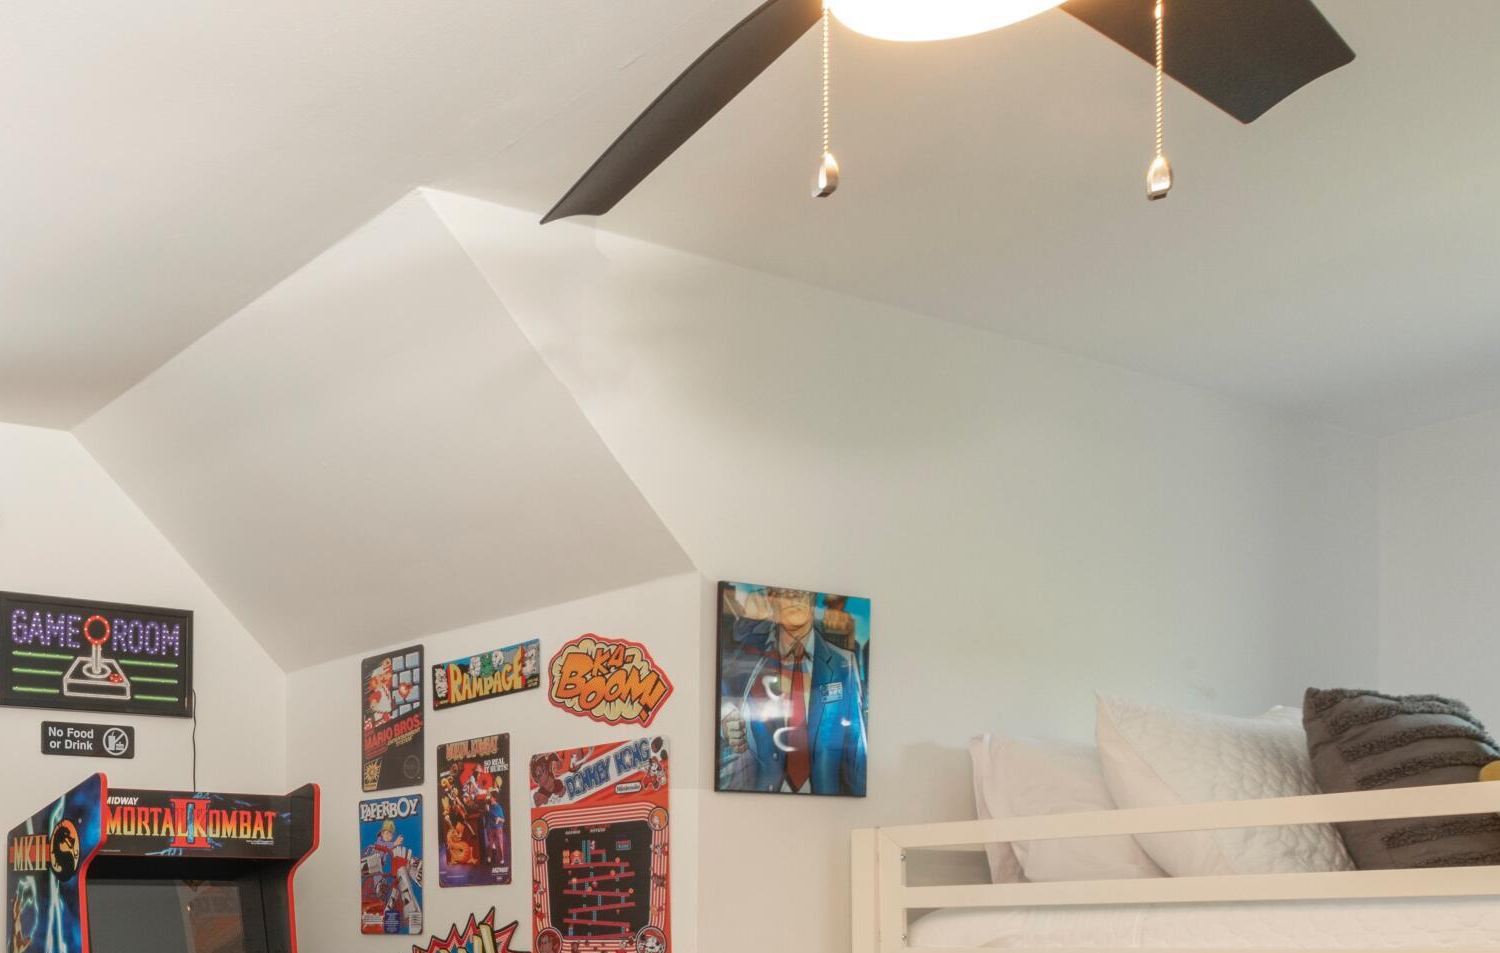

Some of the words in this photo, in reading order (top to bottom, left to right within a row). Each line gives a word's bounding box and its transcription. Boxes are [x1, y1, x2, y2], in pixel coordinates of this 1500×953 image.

[11, 608, 81, 649] GAME
[112, 618, 180, 656] ROOM
[448, 645, 523, 704] RAMPAGE
[555, 652, 668, 723] BOOM!
[48, 727, 64, 738] No
[67, 728, 94, 740] Food
[49, 740, 62, 750] or
[64, 739, 94, 751] Drink
[364, 726, 393, 750] MARIO
[484, 759, 491, 767] SO
[492, 757, 504, 766] REAL
[564, 755, 612, 801] DONKEY
[613, 737, 652, 776] KONG
[616, 783, 640, 792] Nintendo
[360, 797, 419, 822] PAPERBOY
[106, 807, 188, 838] MORTAL
[193, 808, 276, 840] KOMBAT
